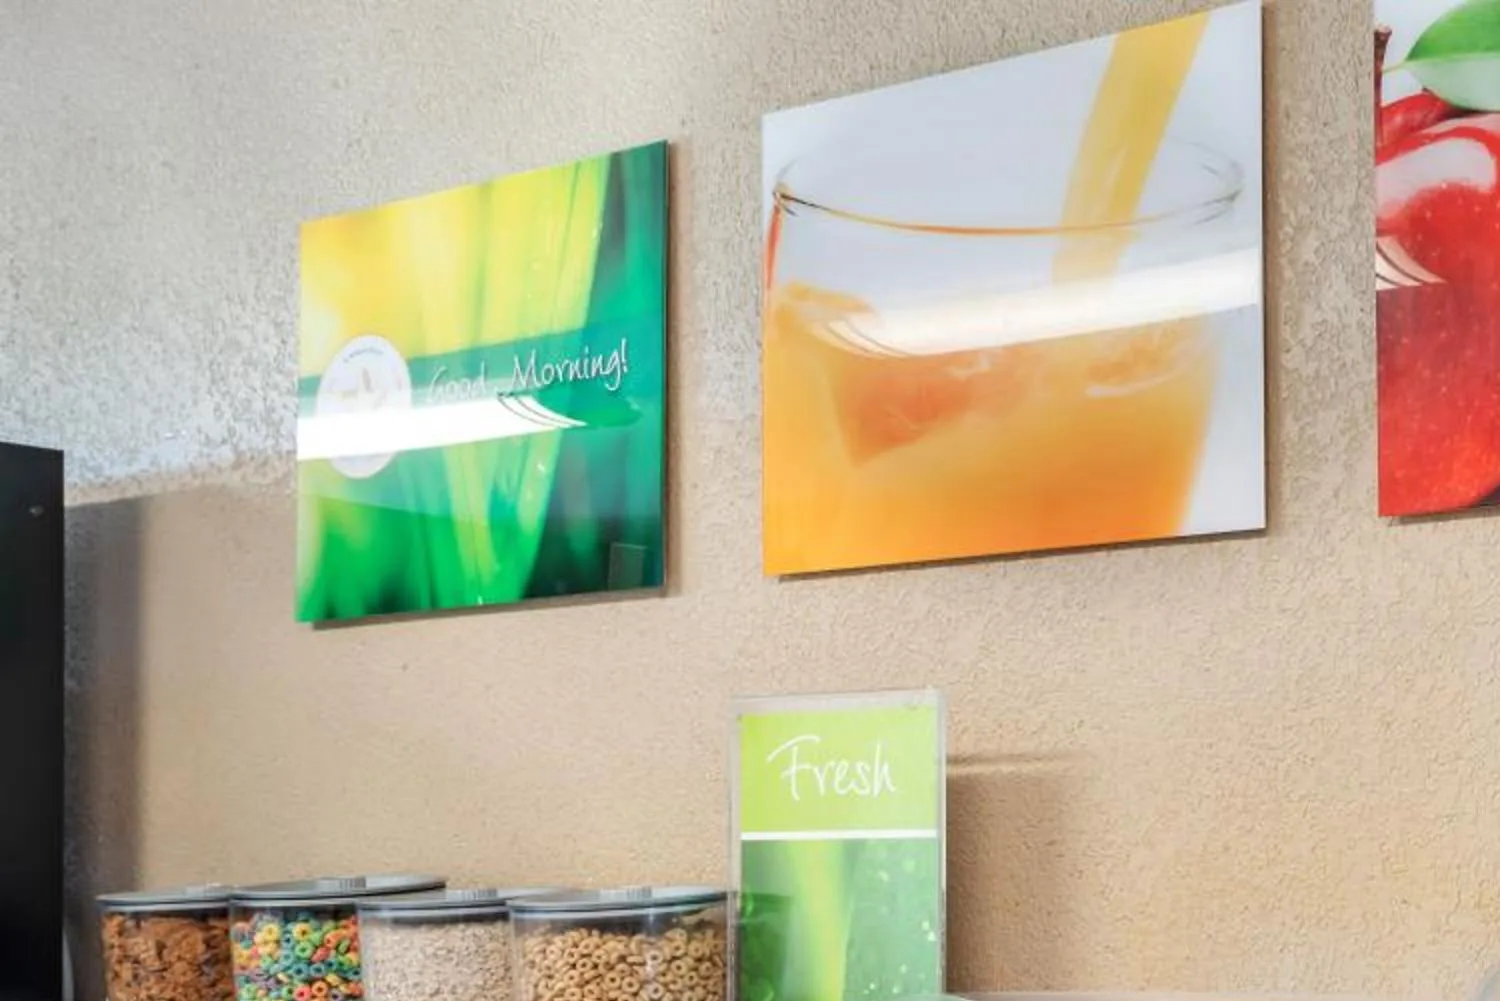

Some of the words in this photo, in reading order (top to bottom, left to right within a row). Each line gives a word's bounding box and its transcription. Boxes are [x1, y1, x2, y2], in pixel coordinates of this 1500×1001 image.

[429, 360, 487, 401] Good
[508, 337, 629, 392] Morning!
[766, 733, 898, 801] Fresh
